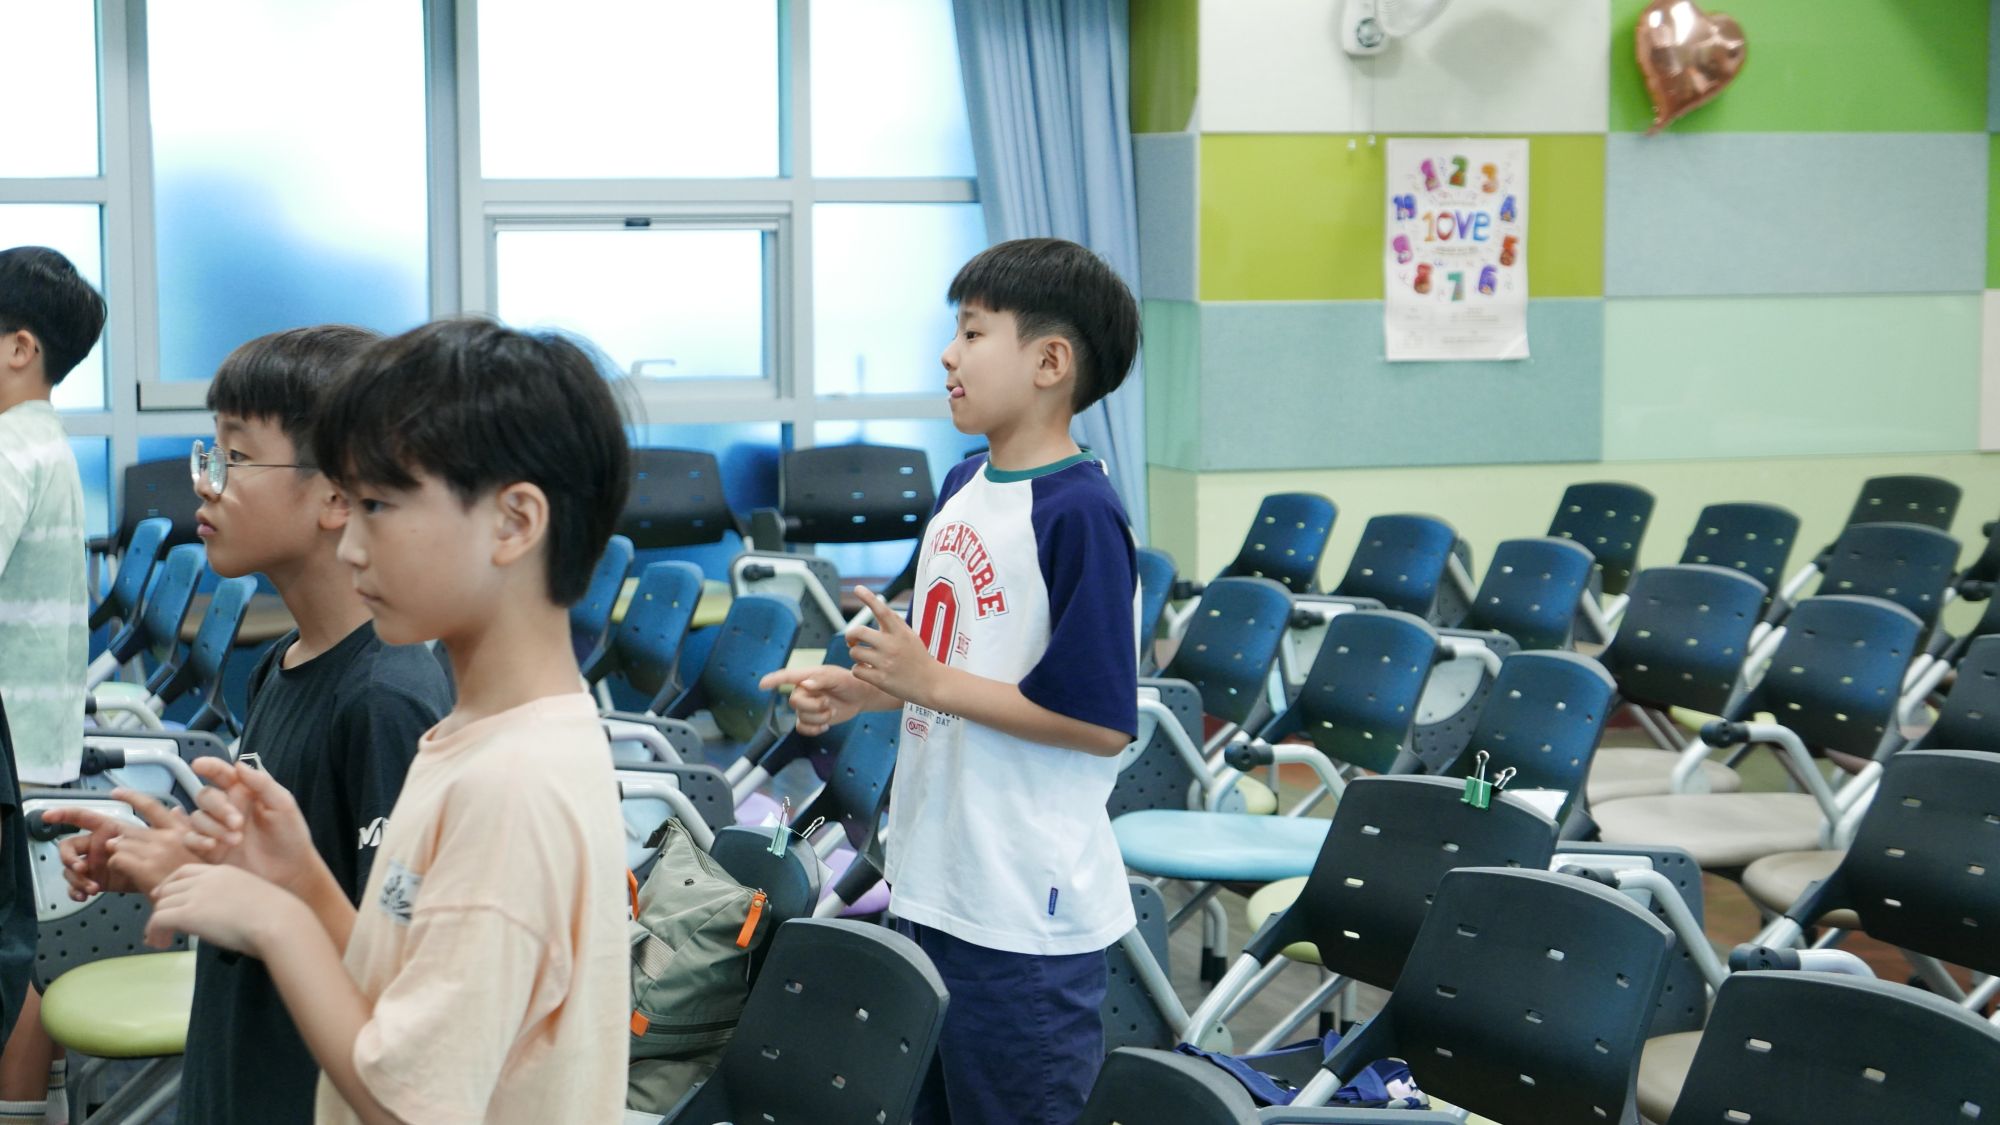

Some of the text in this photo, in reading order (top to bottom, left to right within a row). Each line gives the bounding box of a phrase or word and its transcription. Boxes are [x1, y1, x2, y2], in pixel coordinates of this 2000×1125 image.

[1449, 155, 1468, 187] 2
[1481, 163, 1499, 193] 3
[1447, 272, 1464, 302] 7
[1478, 265, 1498, 295] 6
